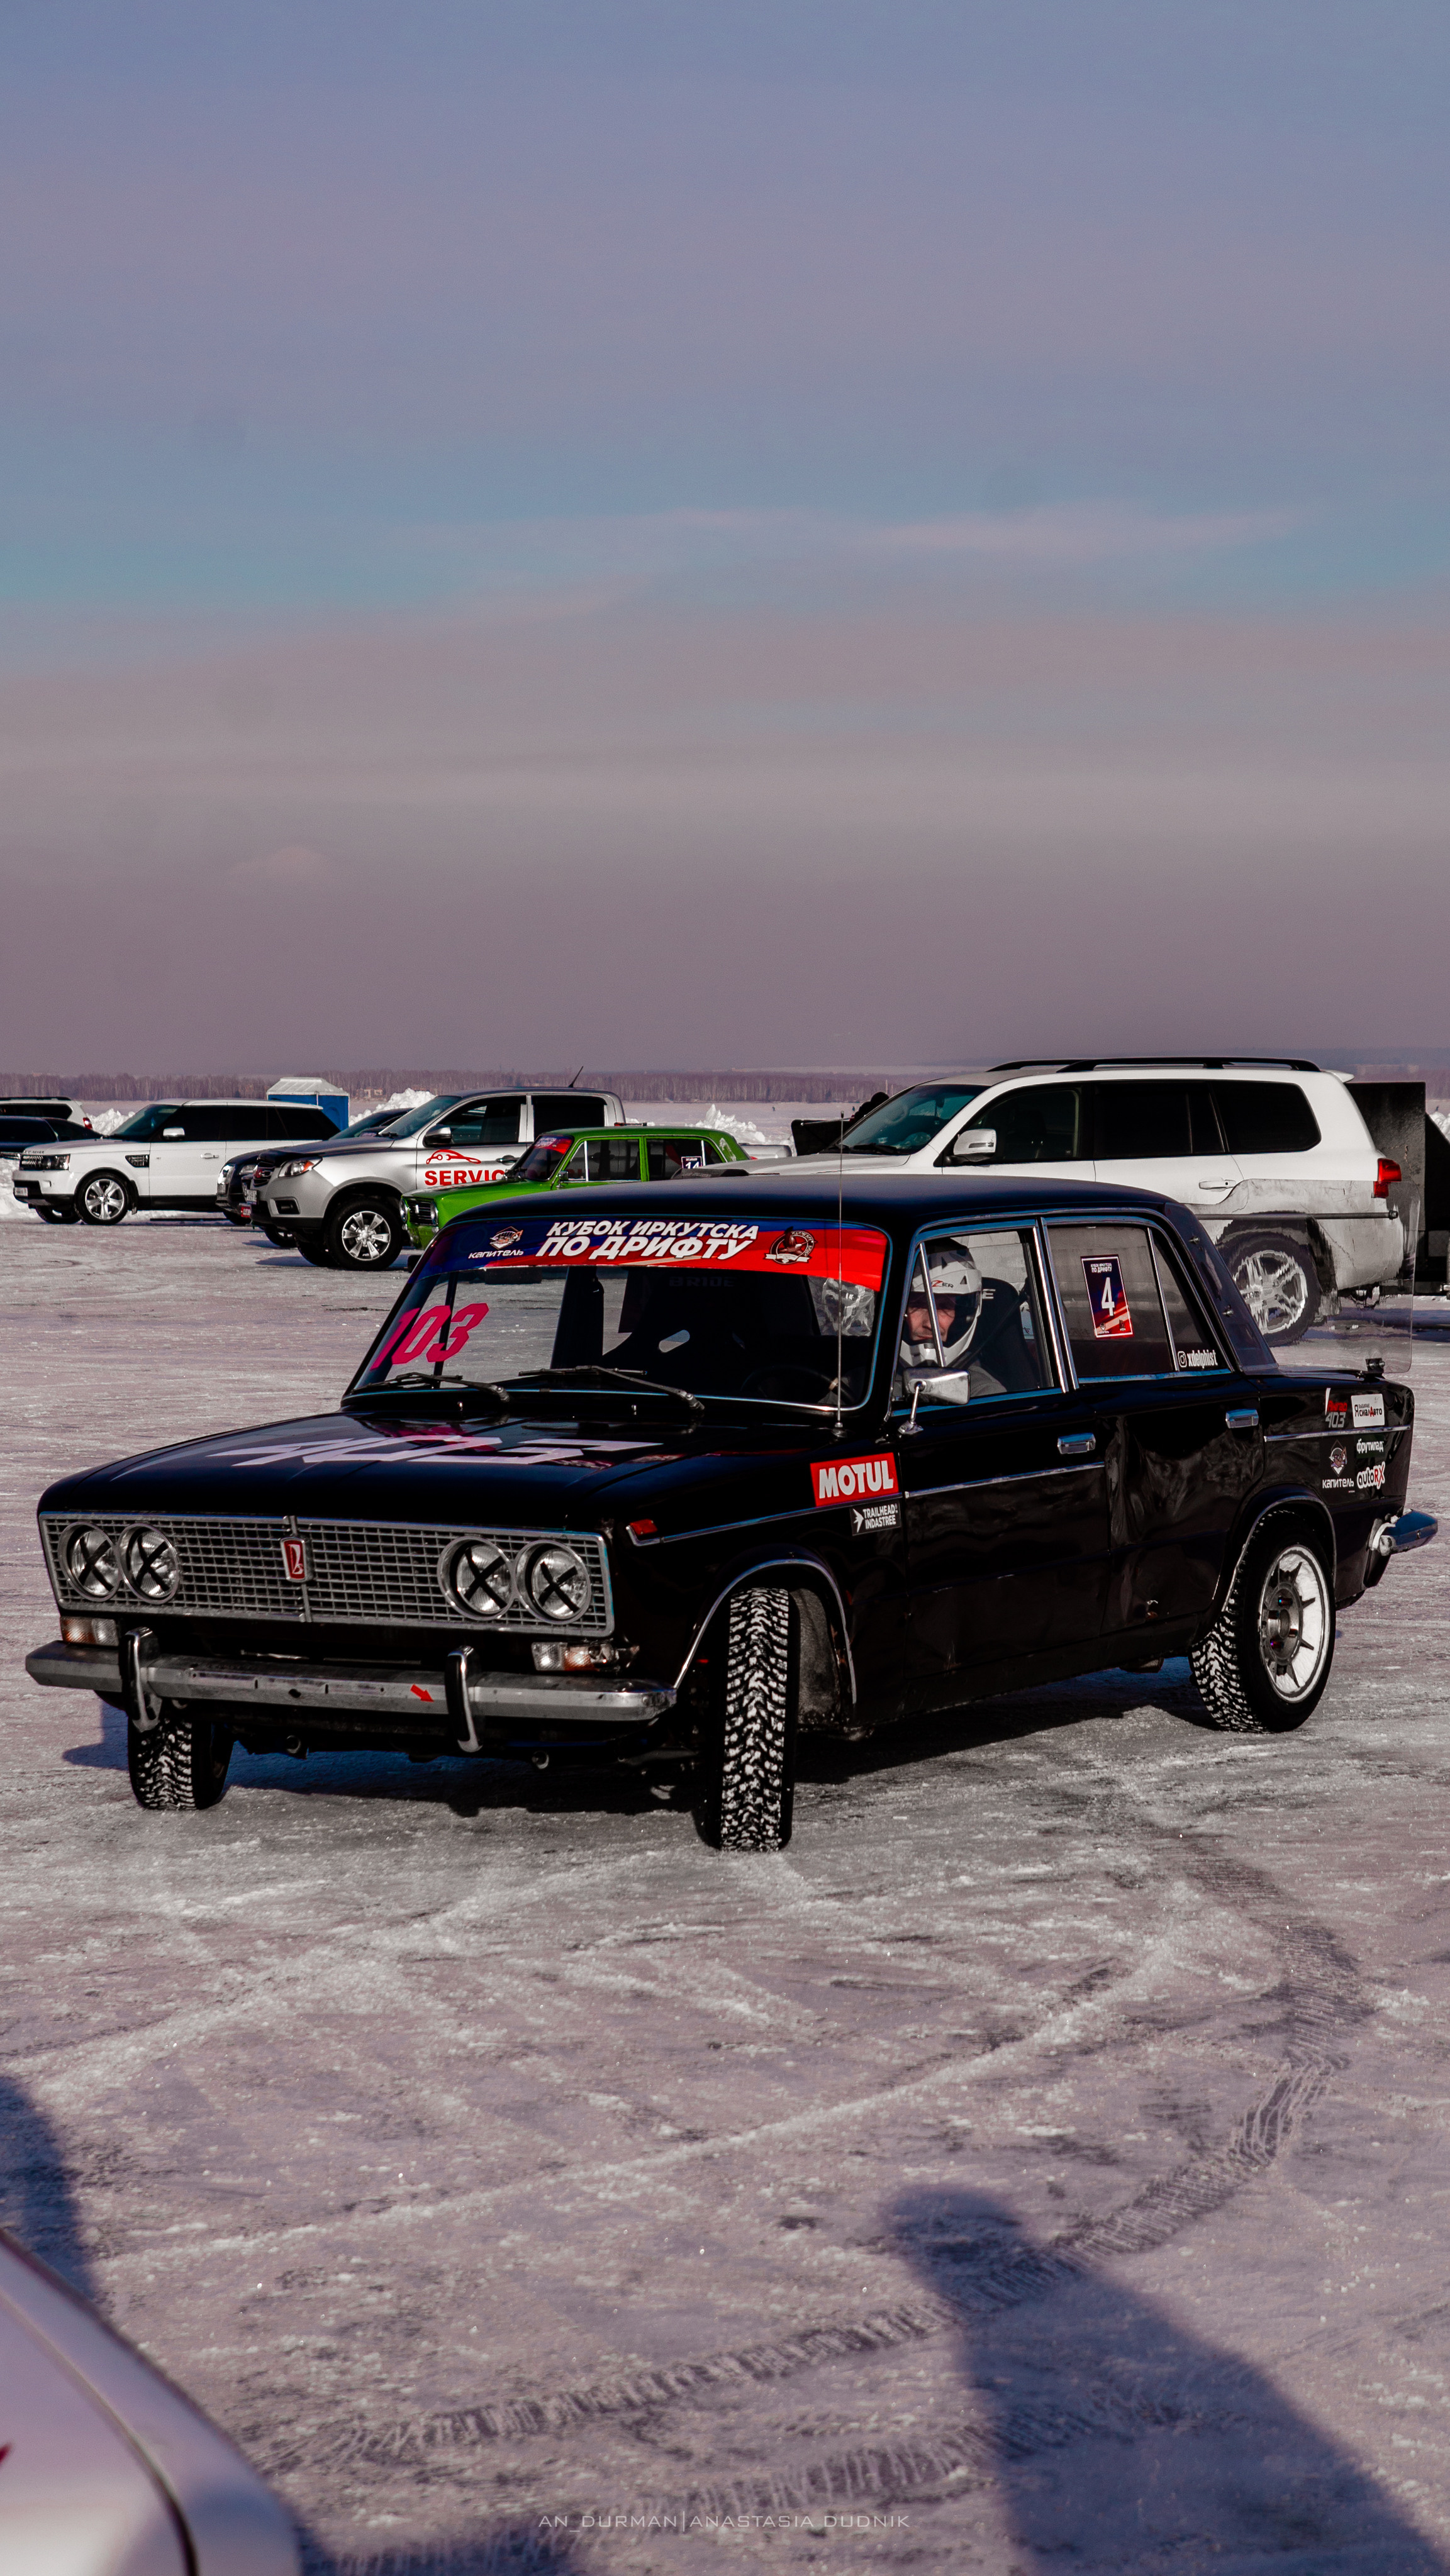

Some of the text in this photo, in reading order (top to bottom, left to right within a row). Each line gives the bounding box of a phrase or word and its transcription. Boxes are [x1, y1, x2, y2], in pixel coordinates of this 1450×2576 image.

[425, 1170, 505, 1185] SERVIC
[547, 1221, 759, 1240] КУБОК ИРКУТСКА
[535, 1236, 753, 1260] ПО ДРИФТУ
[932, 1280, 954, 1288] ZER
[1101, 1277, 1115, 1316] 4
[369, 1302, 489, 1371] 103
[1187, 1349, 1218, 1369] xdelphist
[1325, 1412, 1346, 1428] 403
[819, 1460, 894, 1499] MOTUL
[1357, 1462, 1385, 1489] autoRX
[865, 1515, 896, 1530] INDASTREE
